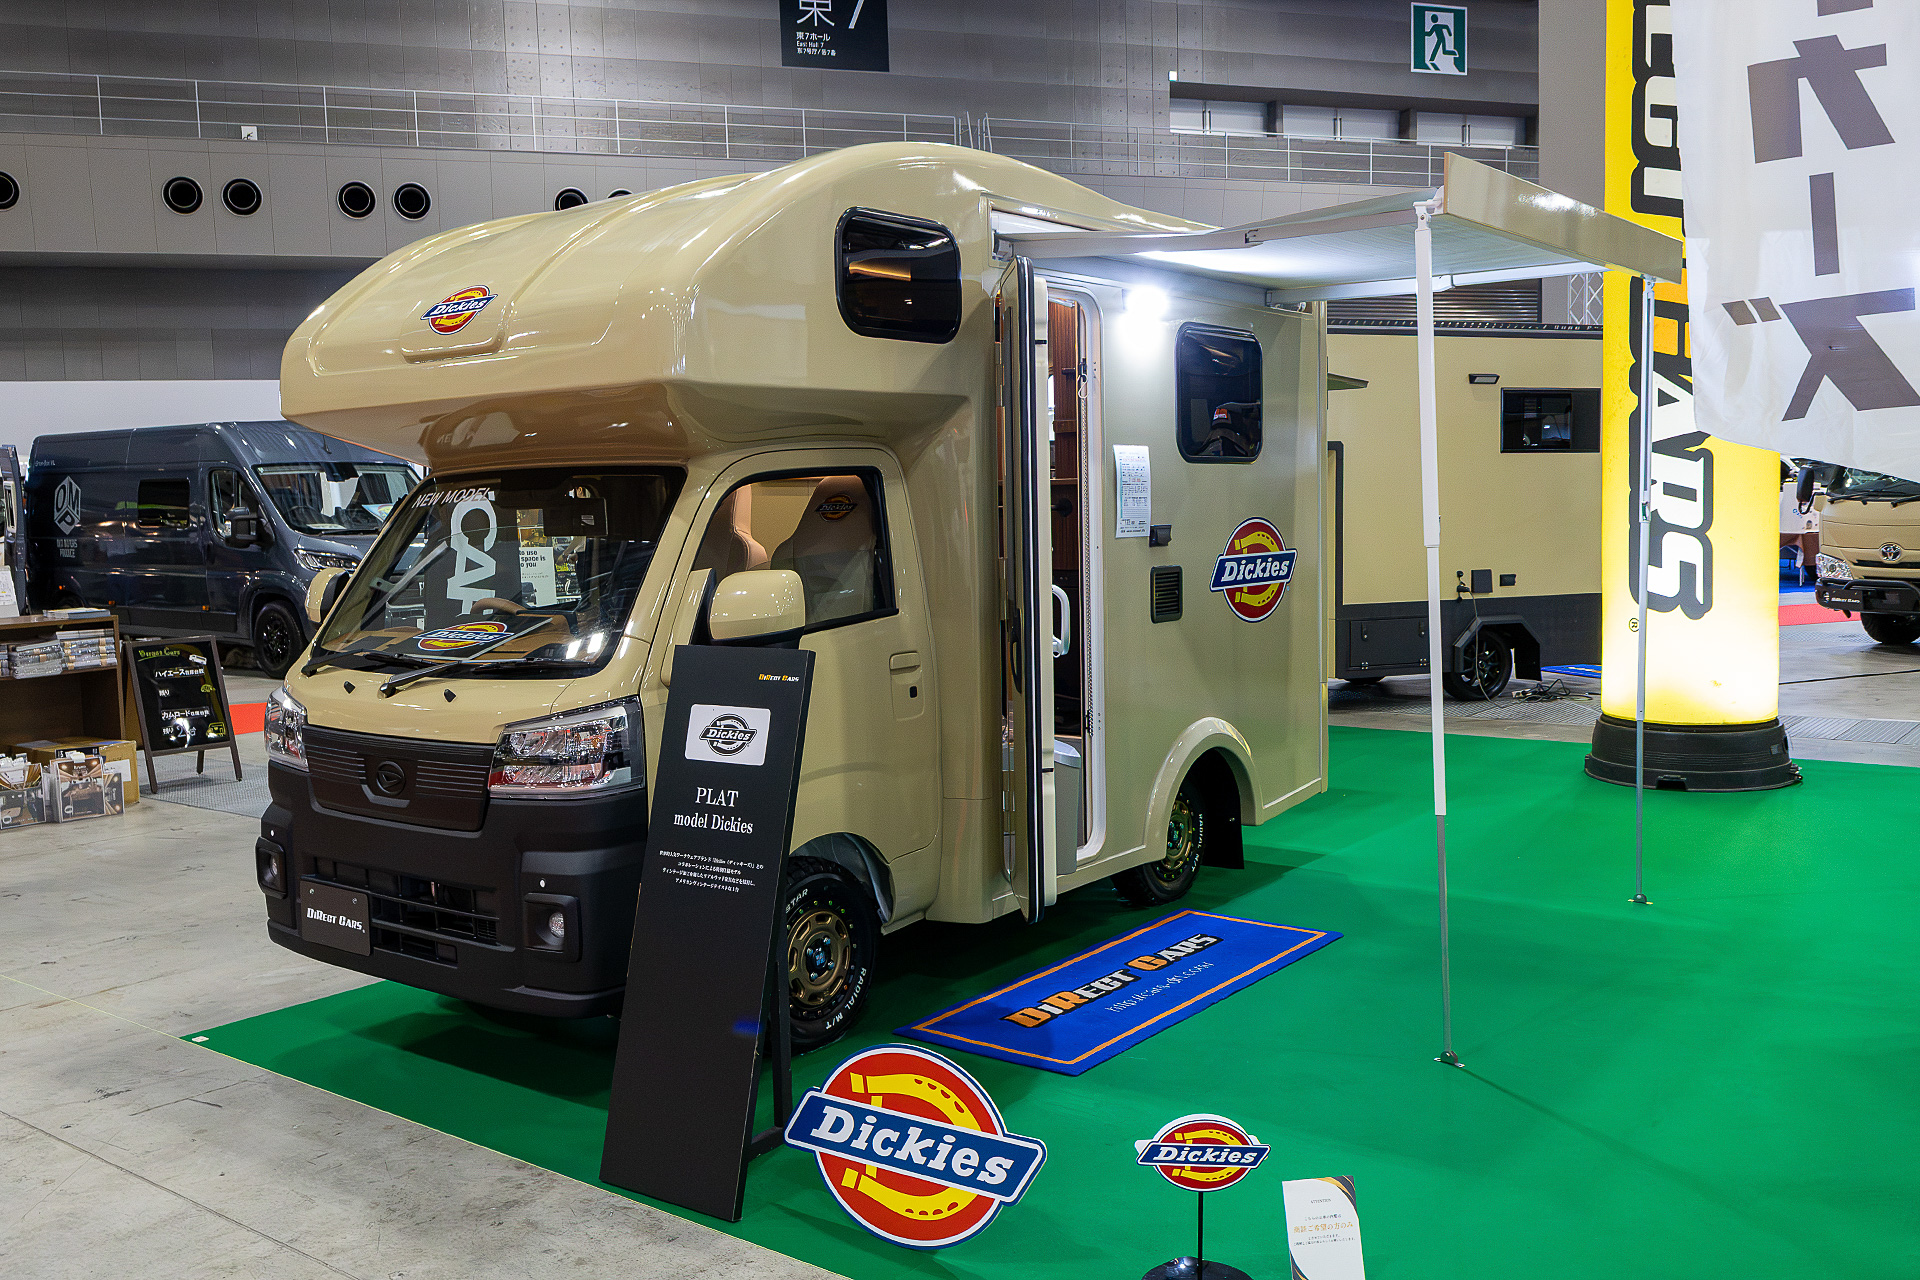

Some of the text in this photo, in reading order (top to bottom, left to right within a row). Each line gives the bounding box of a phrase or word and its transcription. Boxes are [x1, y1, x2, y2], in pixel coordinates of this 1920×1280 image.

[430, 300, 488, 316] Dickies
[411, 487, 491, 508] NEW MODEL
[820, 502, 854, 512] Dickies
[1221, 558, 1290, 582] Dickies
[430, 631, 498, 640] Dickies
[706, 728, 750, 742] Dickies
[695, 786, 739, 808] PLAT
[674, 812, 754, 834] model Dickies
[338, 916, 363, 930] CARS
[844, 967, 867, 1010] RADIAL
[826, 1012, 844, 1030] M/T
[810, 1106, 1014, 1184] Dickies
[1153, 1146, 1258, 1164] Dickies
